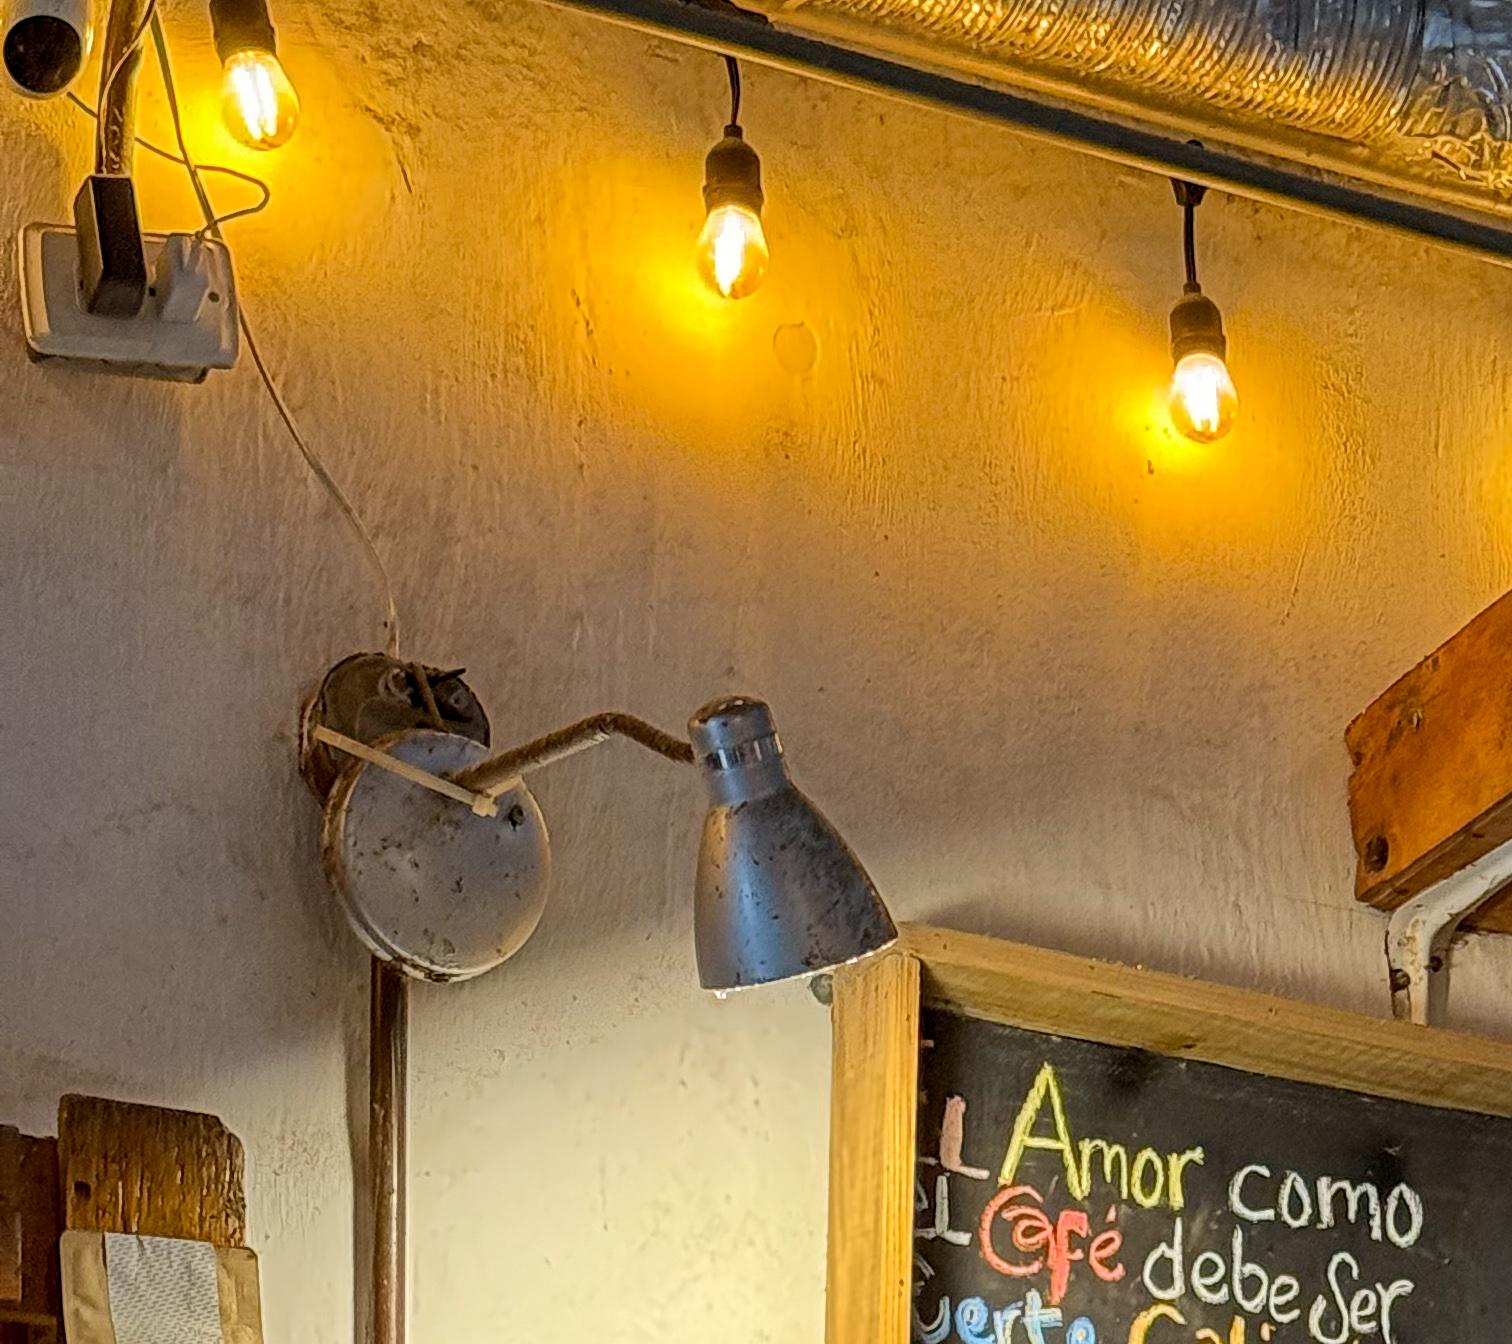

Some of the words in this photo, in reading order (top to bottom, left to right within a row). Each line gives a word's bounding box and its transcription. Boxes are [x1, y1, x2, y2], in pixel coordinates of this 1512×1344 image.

[920, 1095, 990, 1181] L
[998, 1062, 1204, 1208] Amor
[1227, 1163, 1423, 1247] como
[978, 1185, 1125, 1304] Café
[1142, 1215, 1300, 1325] debe
